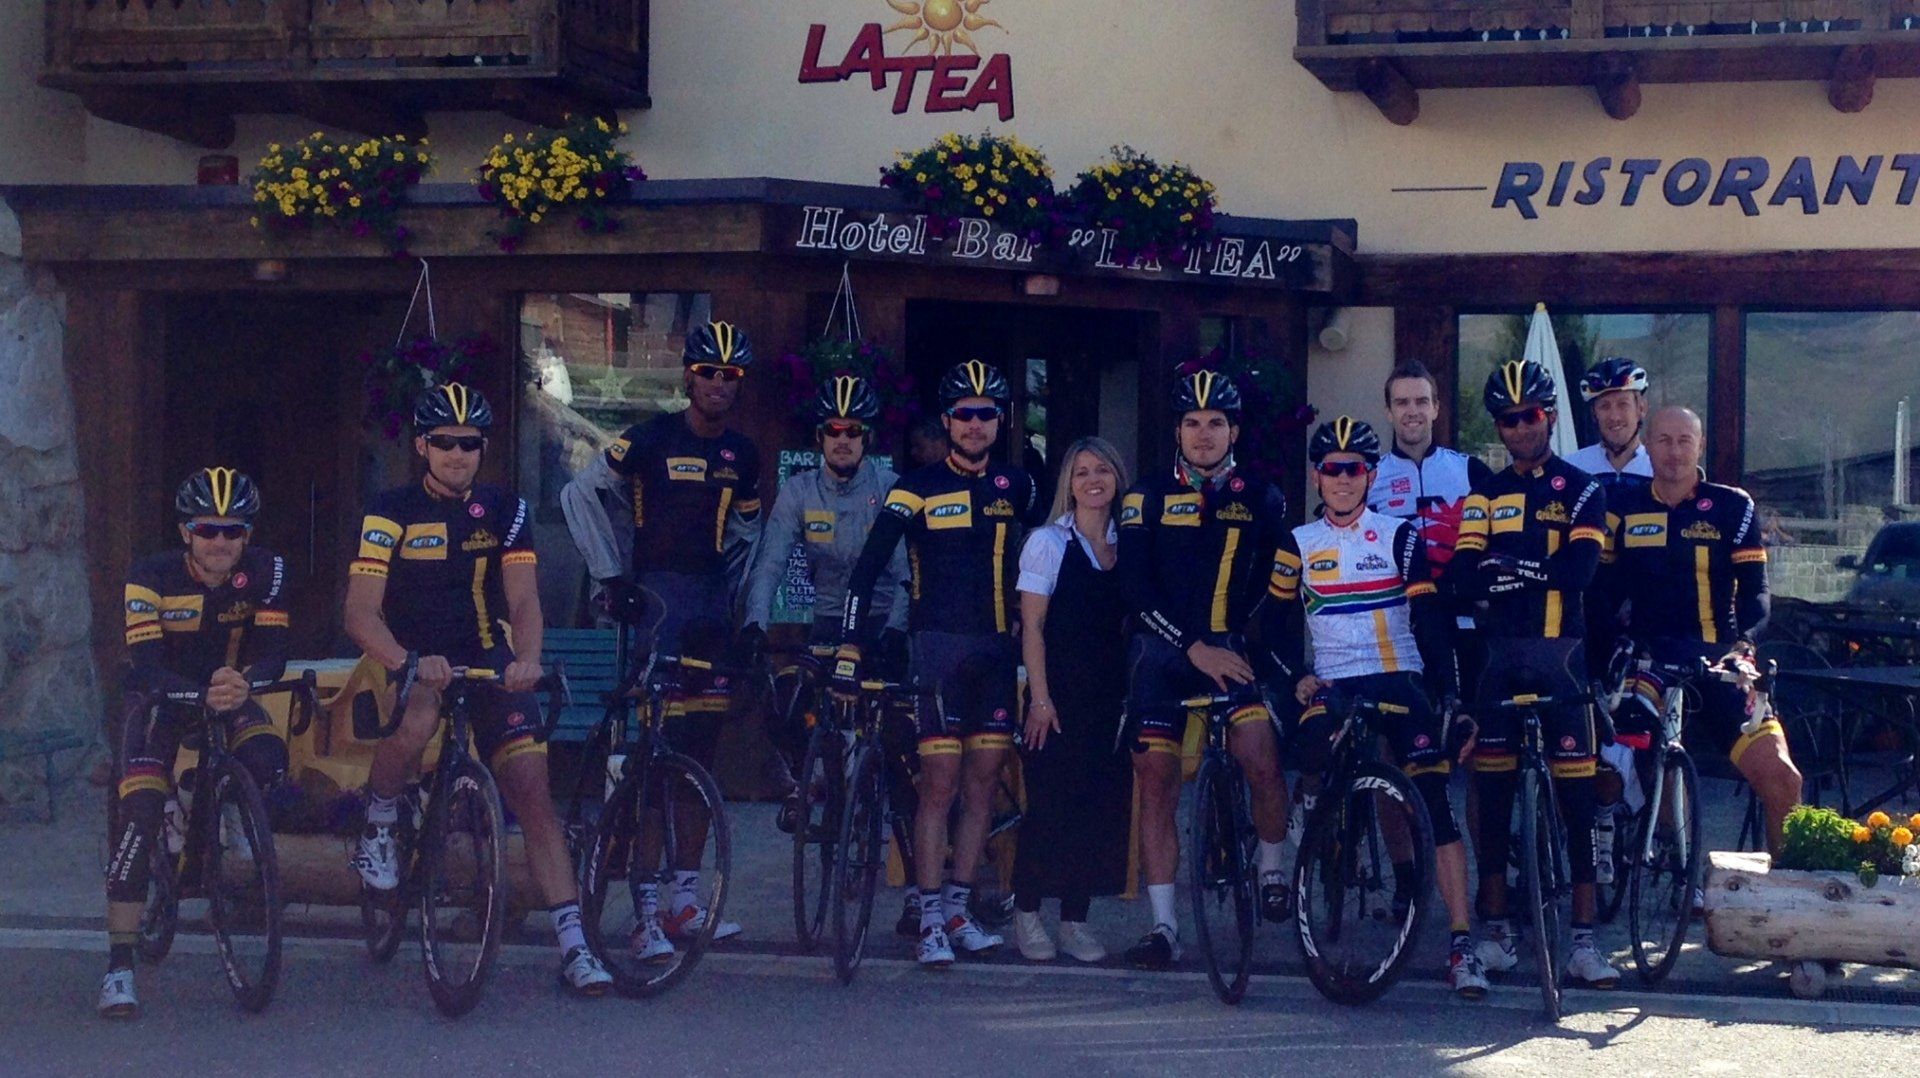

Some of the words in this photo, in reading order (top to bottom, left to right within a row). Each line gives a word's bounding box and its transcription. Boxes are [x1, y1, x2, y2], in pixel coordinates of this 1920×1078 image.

[799, 23, 886, 90] LA
[890, 53, 1014, 121] TEA
[796, 206, 926, 254] Hotel
[953, 217, 1041, 262] Bar
[780, 450, 815, 466] BAR
[934, 503, 964, 515] MTN
[1493, 506, 1516, 517] MTN
[1631, 526, 1659, 535] MTN
